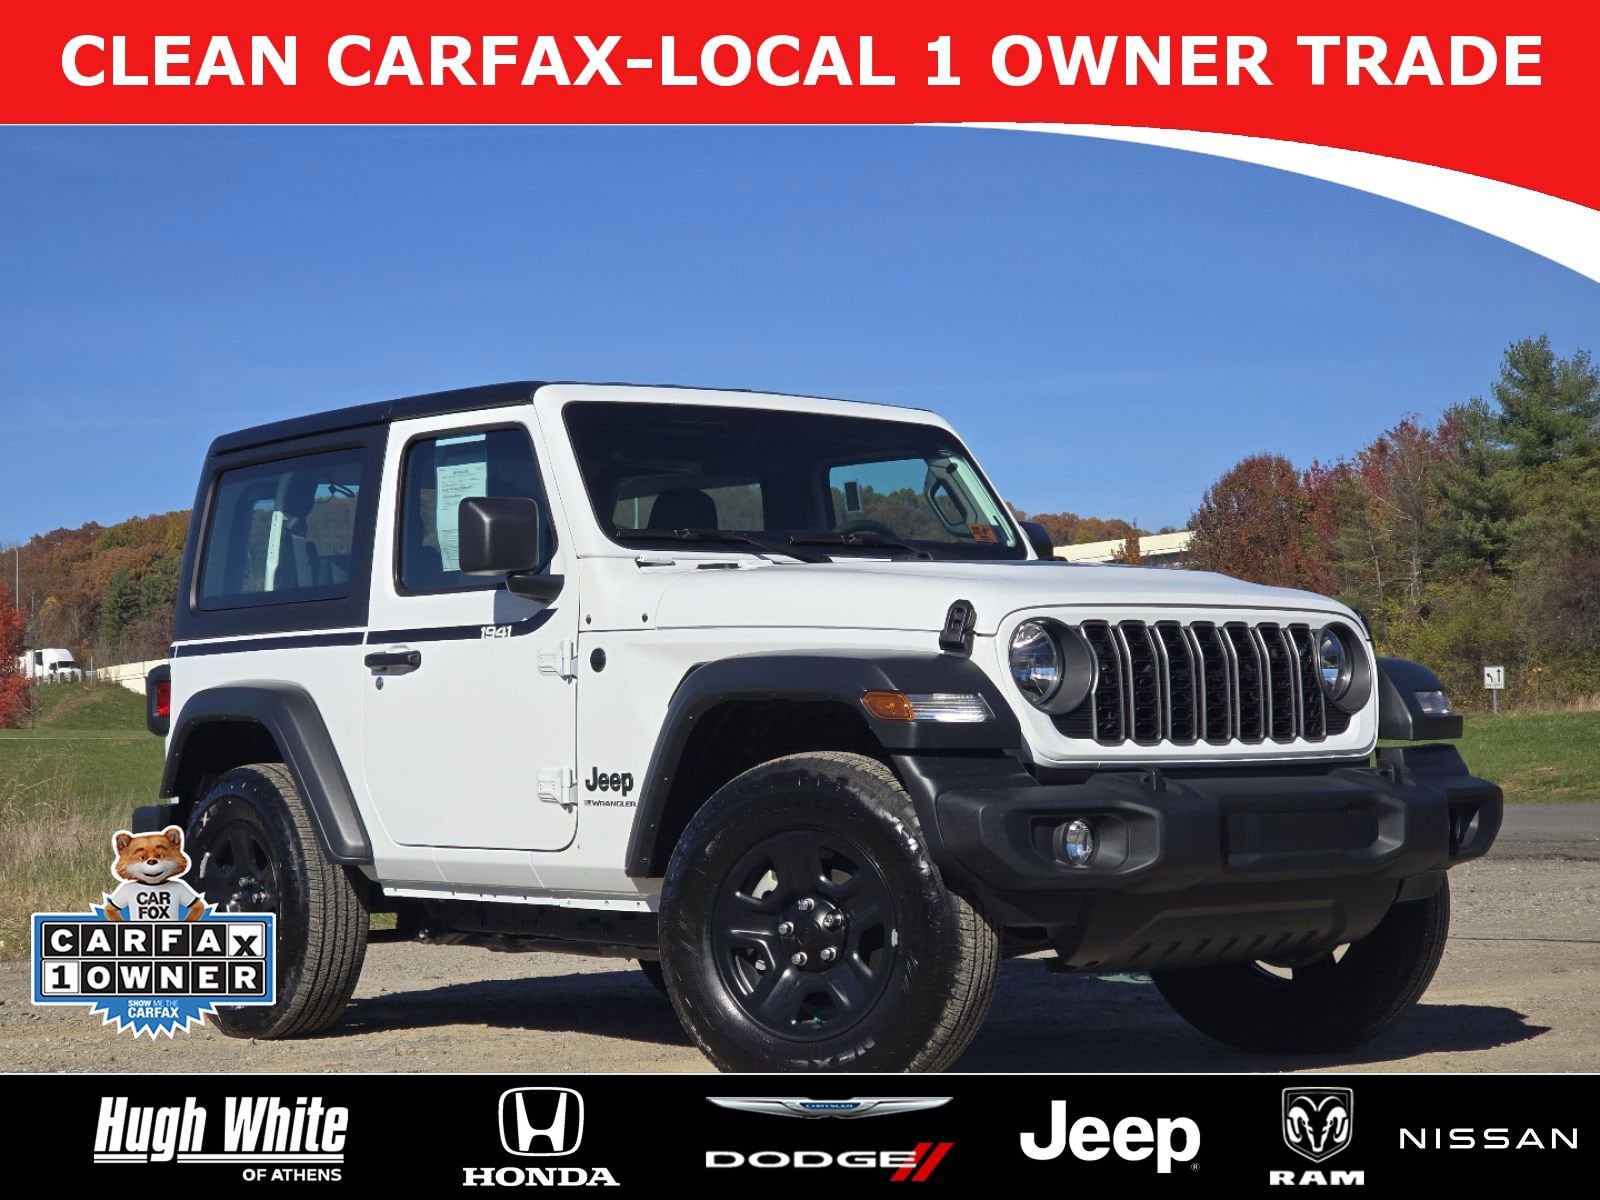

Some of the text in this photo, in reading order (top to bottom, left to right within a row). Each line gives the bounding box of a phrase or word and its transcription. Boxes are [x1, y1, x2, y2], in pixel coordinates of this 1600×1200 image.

[480, 625, 512, 639] 1941
[585, 766, 634, 796] Jeep
[591, 799, 636, 807] WRANGLER
